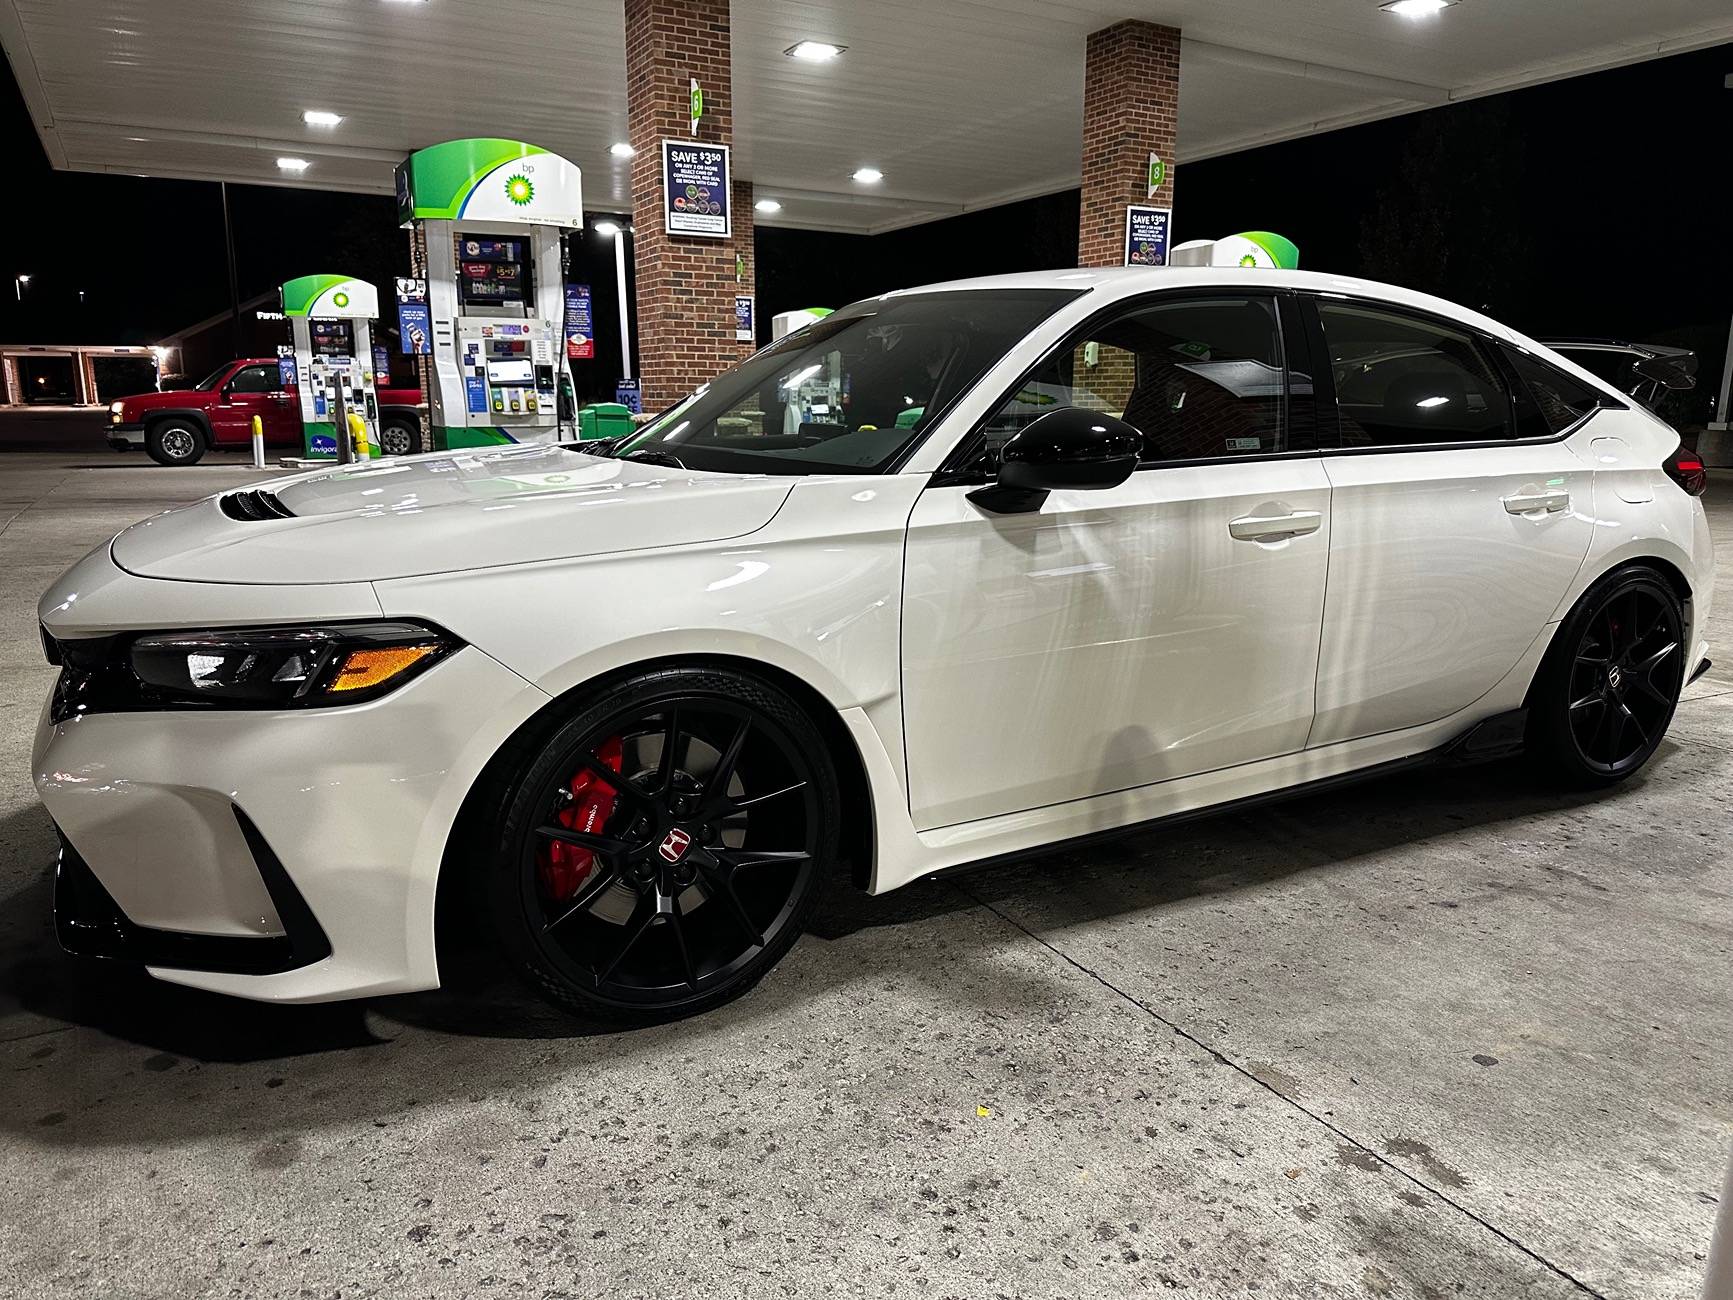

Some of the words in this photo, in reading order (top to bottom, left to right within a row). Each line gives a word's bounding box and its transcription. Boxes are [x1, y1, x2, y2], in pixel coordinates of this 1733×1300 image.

[693, 94, 699, 112] 6
[671, 150, 698, 164] SAVE
[522, 163, 535, 174] bp
[1153, 166, 1160, 180] 8
[572, 218, 578, 227] 6
[1132, 214, 1151, 225] SAVE
[545, 320, 551, 328] 6
